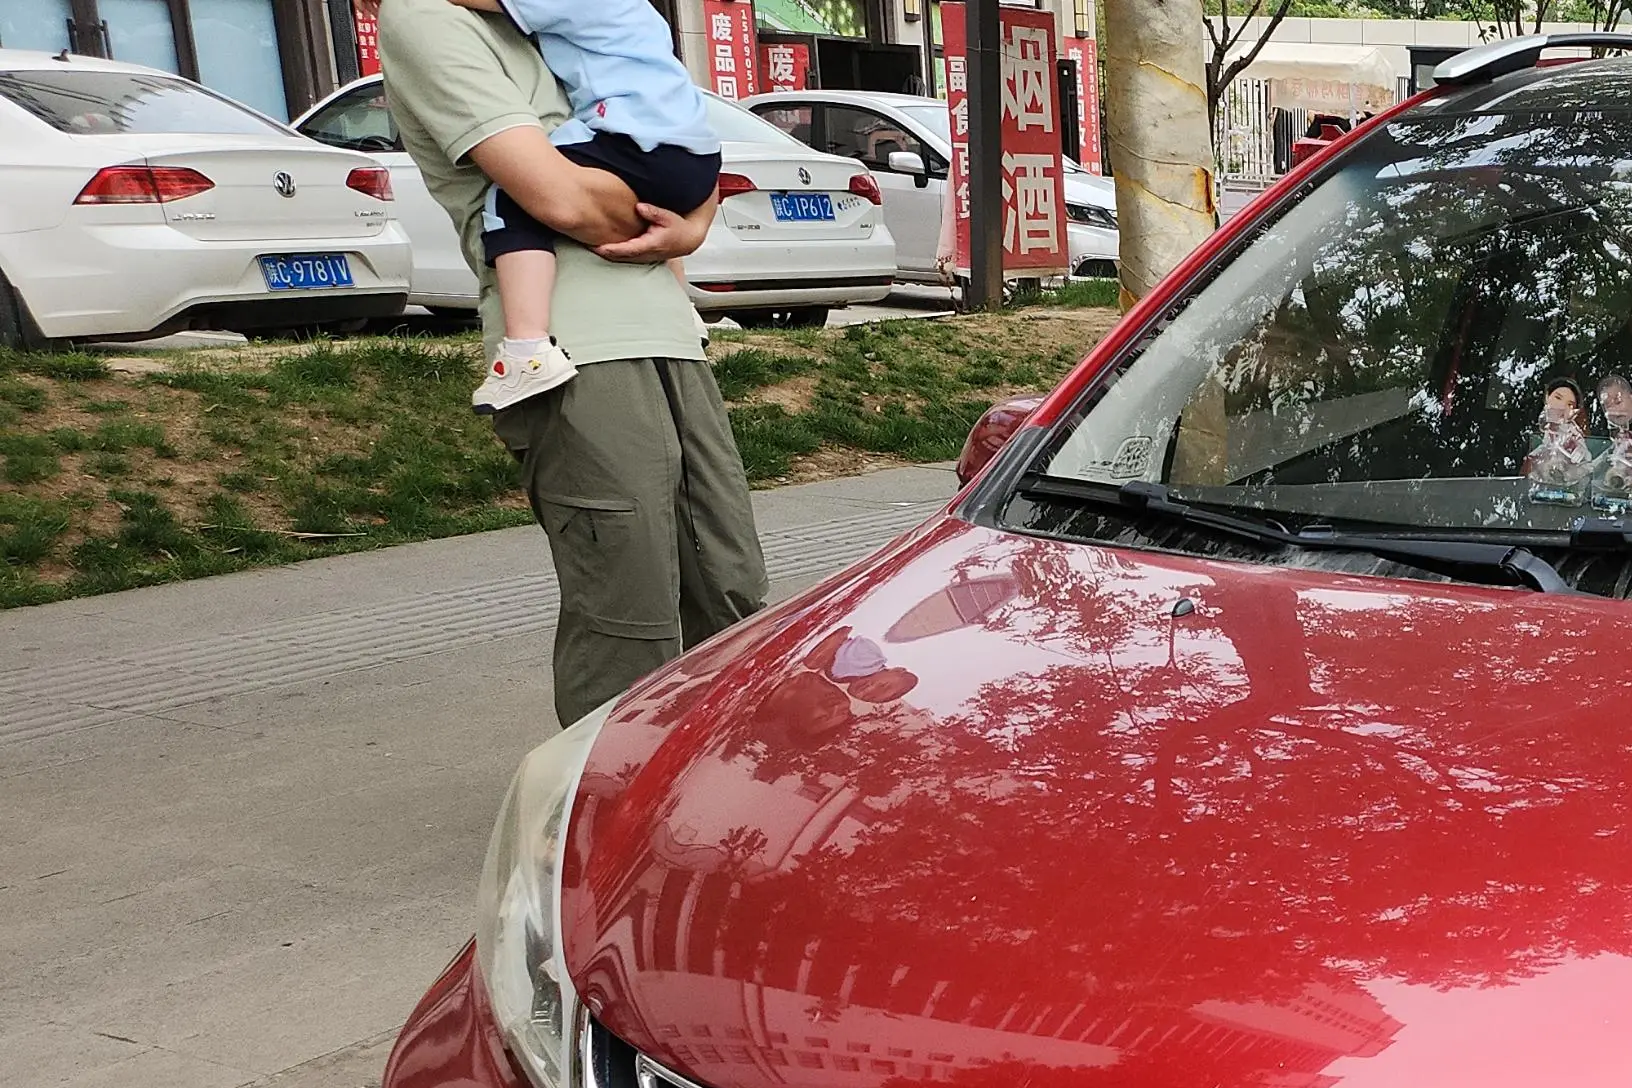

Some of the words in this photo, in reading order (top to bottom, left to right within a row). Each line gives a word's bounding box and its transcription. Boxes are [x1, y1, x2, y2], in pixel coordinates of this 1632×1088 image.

[711, 12, 738, 101] 废品回
[740, 9, 754, 97] 1589056
[1000, 20, 1058, 255] 烟酒
